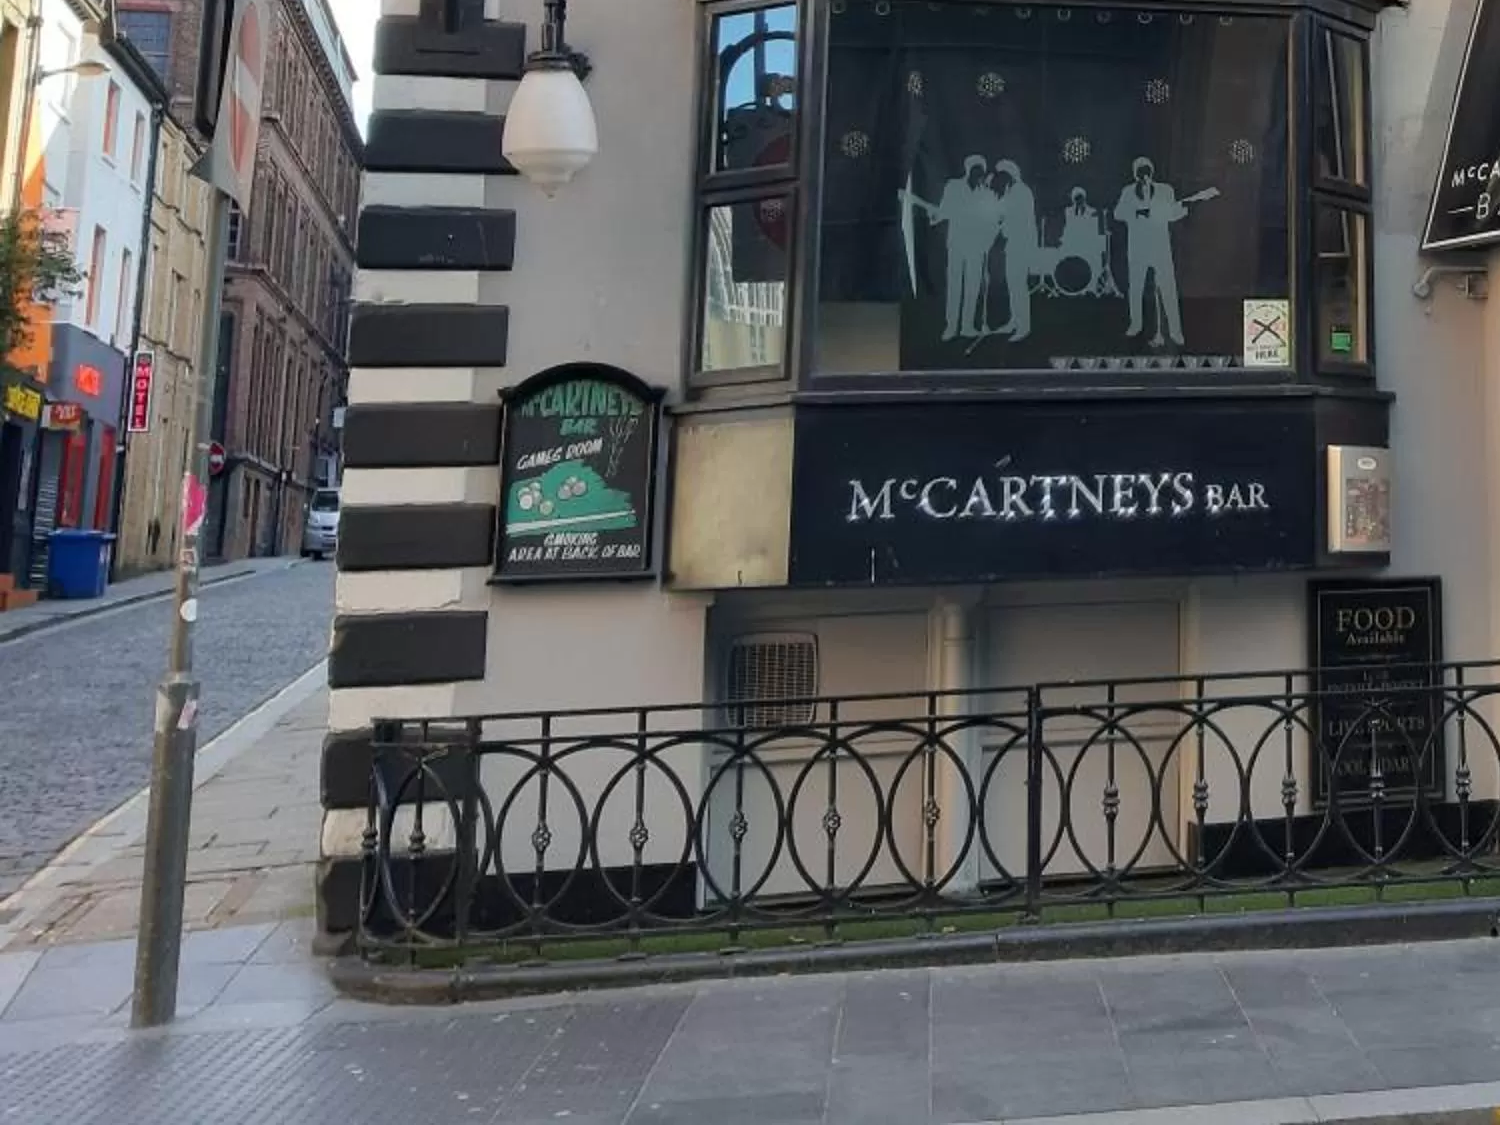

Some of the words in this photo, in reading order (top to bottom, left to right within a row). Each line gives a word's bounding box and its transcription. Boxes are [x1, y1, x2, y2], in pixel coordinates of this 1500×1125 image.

[516, 446, 564, 471] GAMES
[565, 436, 604, 460] ROOM
[846, 472, 1195, 522] McCARTNEYS
[1205, 482, 1269, 514] BAR
[543, 532, 599, 546] SMOKING
[508, 548, 542, 562] AREA
[544, 546, 559, 560] AT
[561, 545, 599, 560] BACK
[601, 545, 616, 558] OF
[617, 544, 642, 559] BAR
[1336, 606, 1416, 632] FOOD
[1346, 631, 1405, 645] Available
